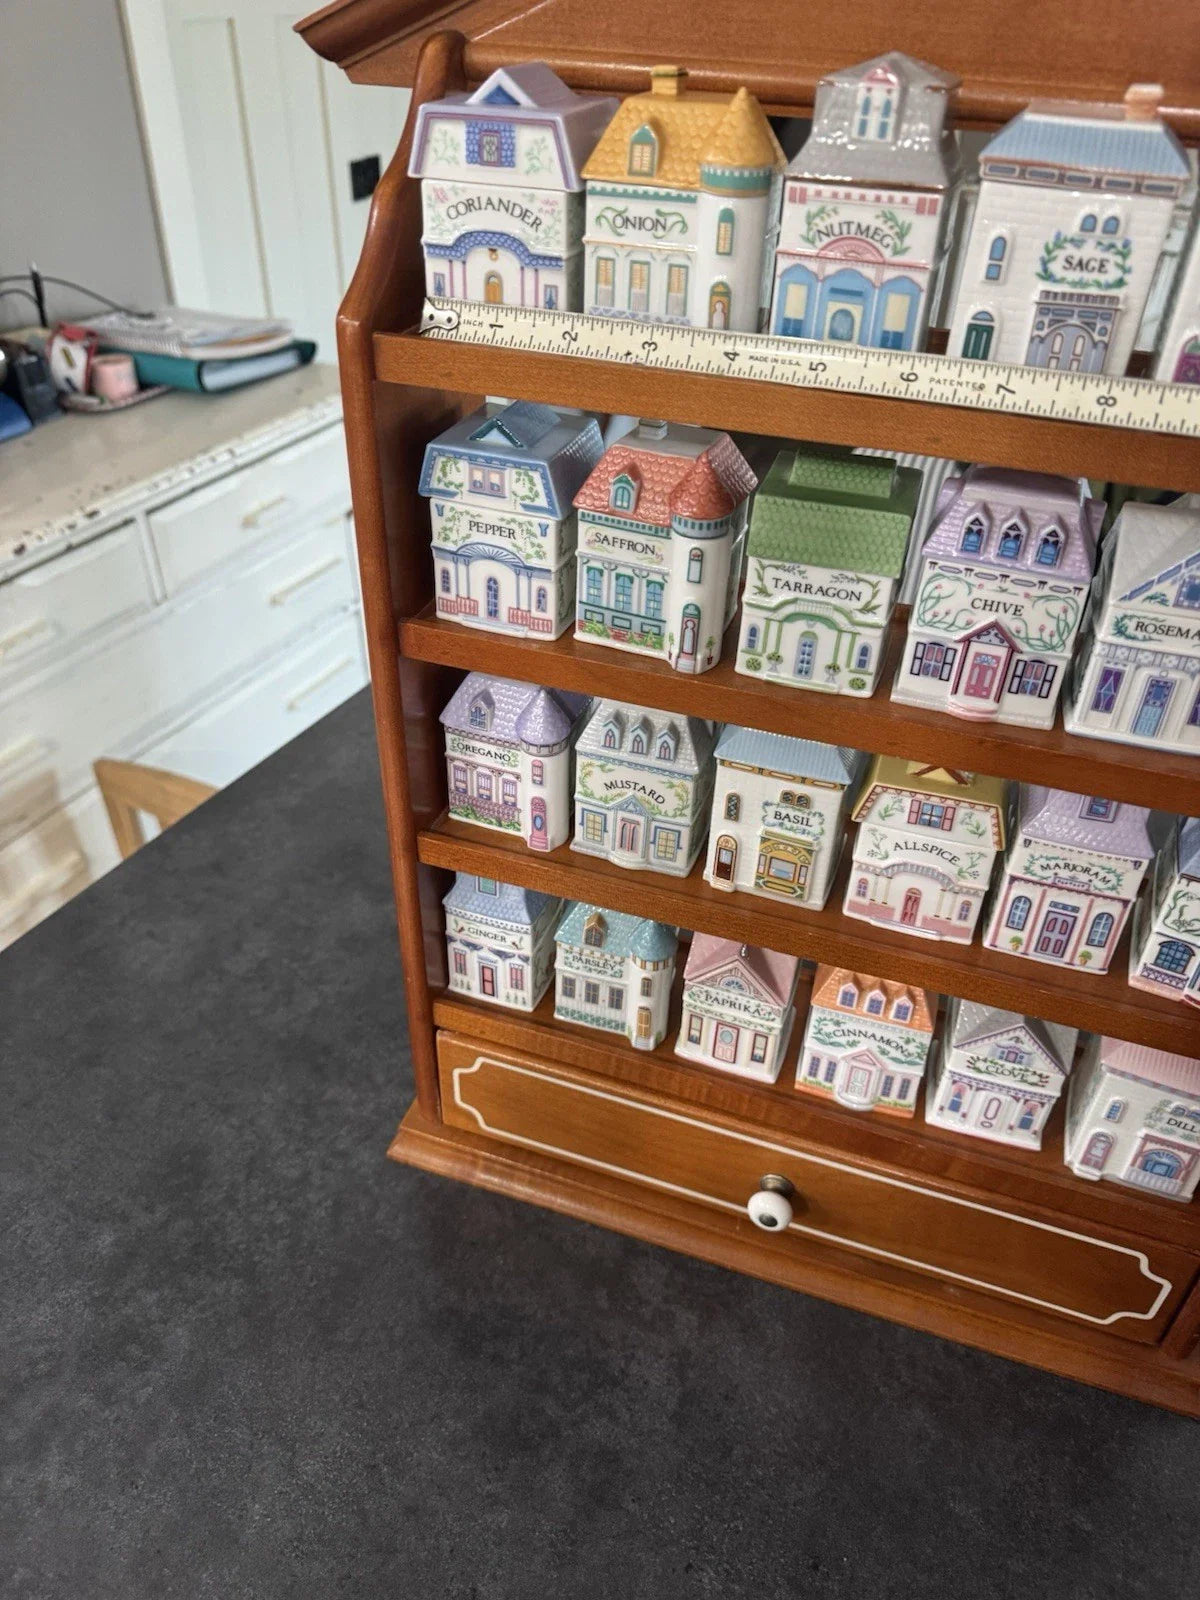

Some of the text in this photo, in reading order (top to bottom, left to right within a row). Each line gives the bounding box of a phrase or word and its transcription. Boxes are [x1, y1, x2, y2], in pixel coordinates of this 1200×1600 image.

[446, 197, 543, 231] CORIANDER
[612, 213, 668, 232] ONION
[816, 221, 896, 248] NUTMEG
[1062, 255, 1110, 274] SAGE
[463, 319, 484, 328] INCH
[563, 330, 579, 342] 2
[641, 341, 658, 352] 3
[723, 351, 740, 362] 4
[748, 355, 769, 363] MADE
[809, 361, 828, 373] 5
[900, 371, 919, 383] 6
[995, 383, 1017, 395] 7
[1096, 395, 1117, 407] 8
[468, 519, 517, 540] PEPPER
[593, 531, 656, 556] SAFFRON
[772, 577, 862, 601] TARRAGON
[970, 598, 1025, 617] CHIVE
[457, 741, 512, 762] OREGANO
[604, 779, 666, 805] MUSTARD
[773, 810, 814, 828] BASIL
[893, 840, 961, 866] ALLSPICE
[1040, 862, 1111, 885] MARJORAM
[467, 926, 507, 944] GINGER
[571, 955, 618, 972] PARSLEY
[704, 993, 762, 1017] PAPRIKA
[833, 1028, 909, 1054] CINNAMON
[985, 1063, 1030, 1081] CLOVE
[1166, 1117, 1197, 1133] DILL
